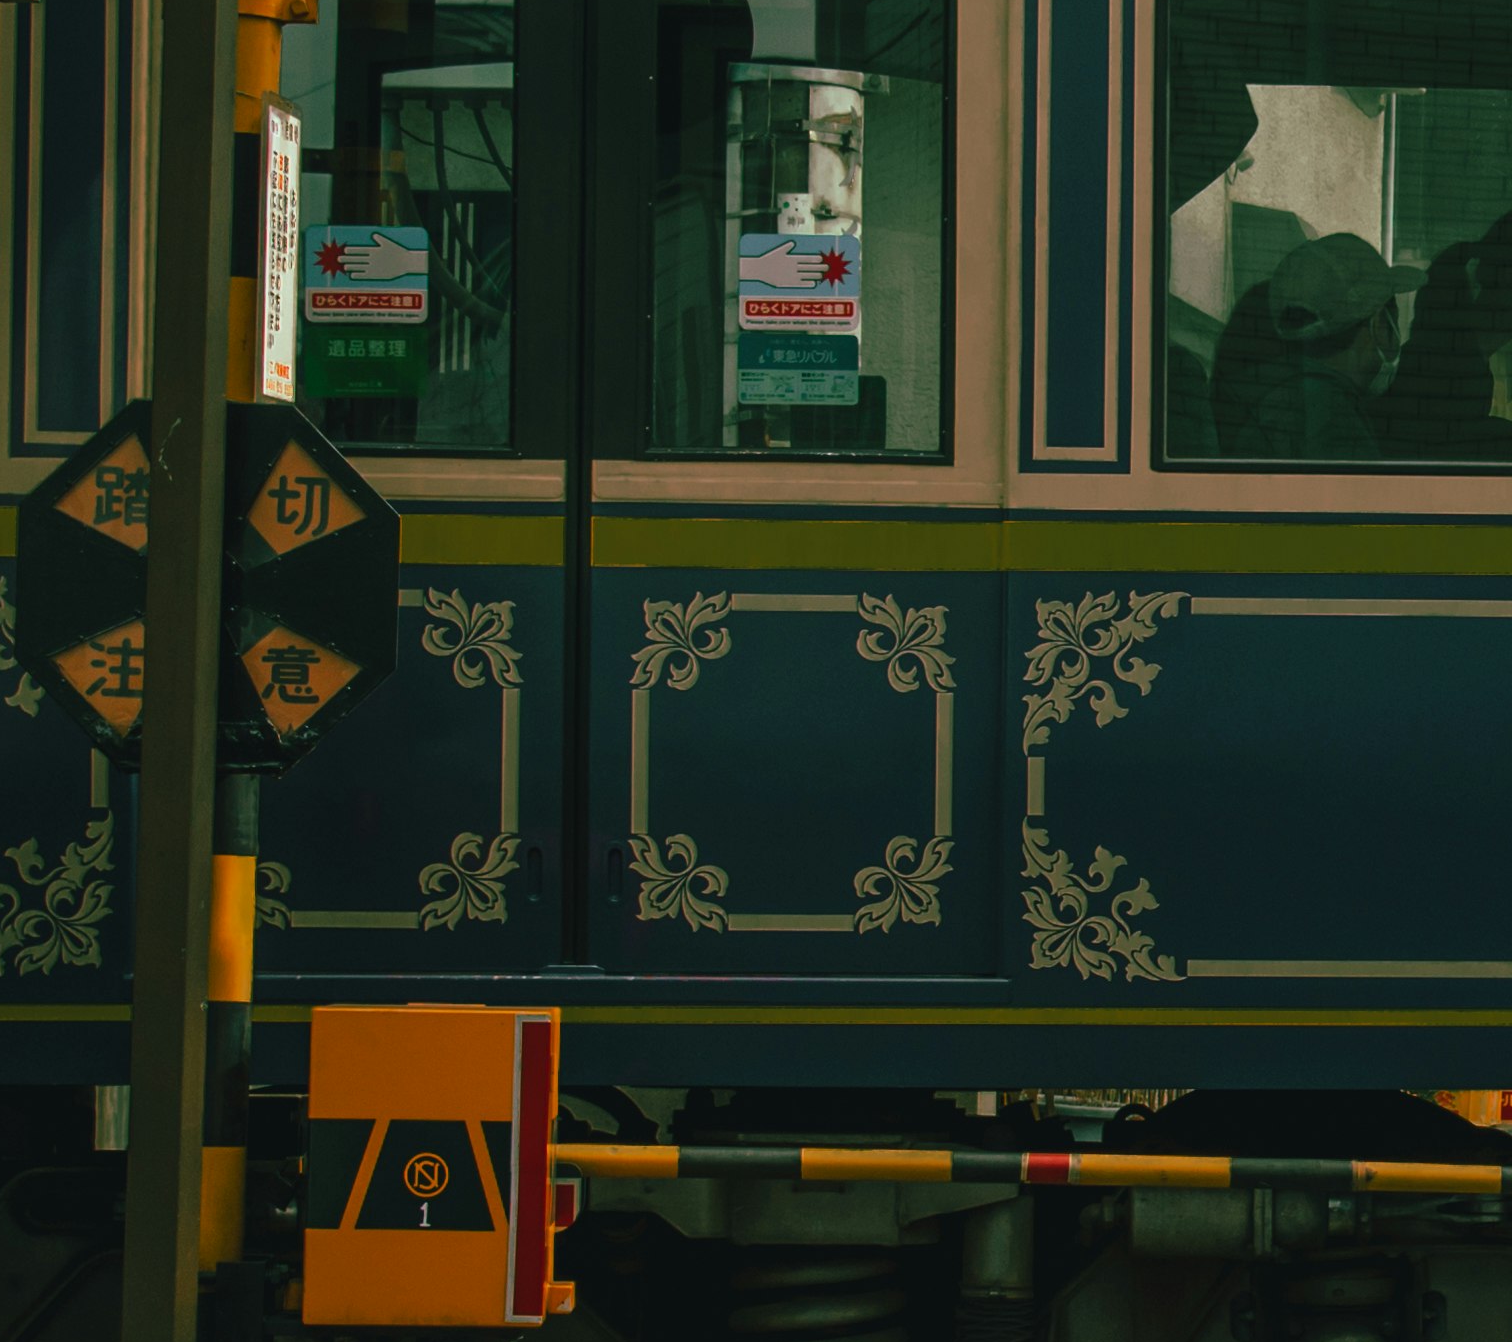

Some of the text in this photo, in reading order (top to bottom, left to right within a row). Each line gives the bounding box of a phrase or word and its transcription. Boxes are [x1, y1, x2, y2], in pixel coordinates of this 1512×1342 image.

[314, 294, 420, 307] ひらくドアにご注意！
[749, 302, 851, 315] ひらくドアにご注意！
[328, 339, 406, 358] 遺品整理
[419, 1201, 432, 1228] 1
